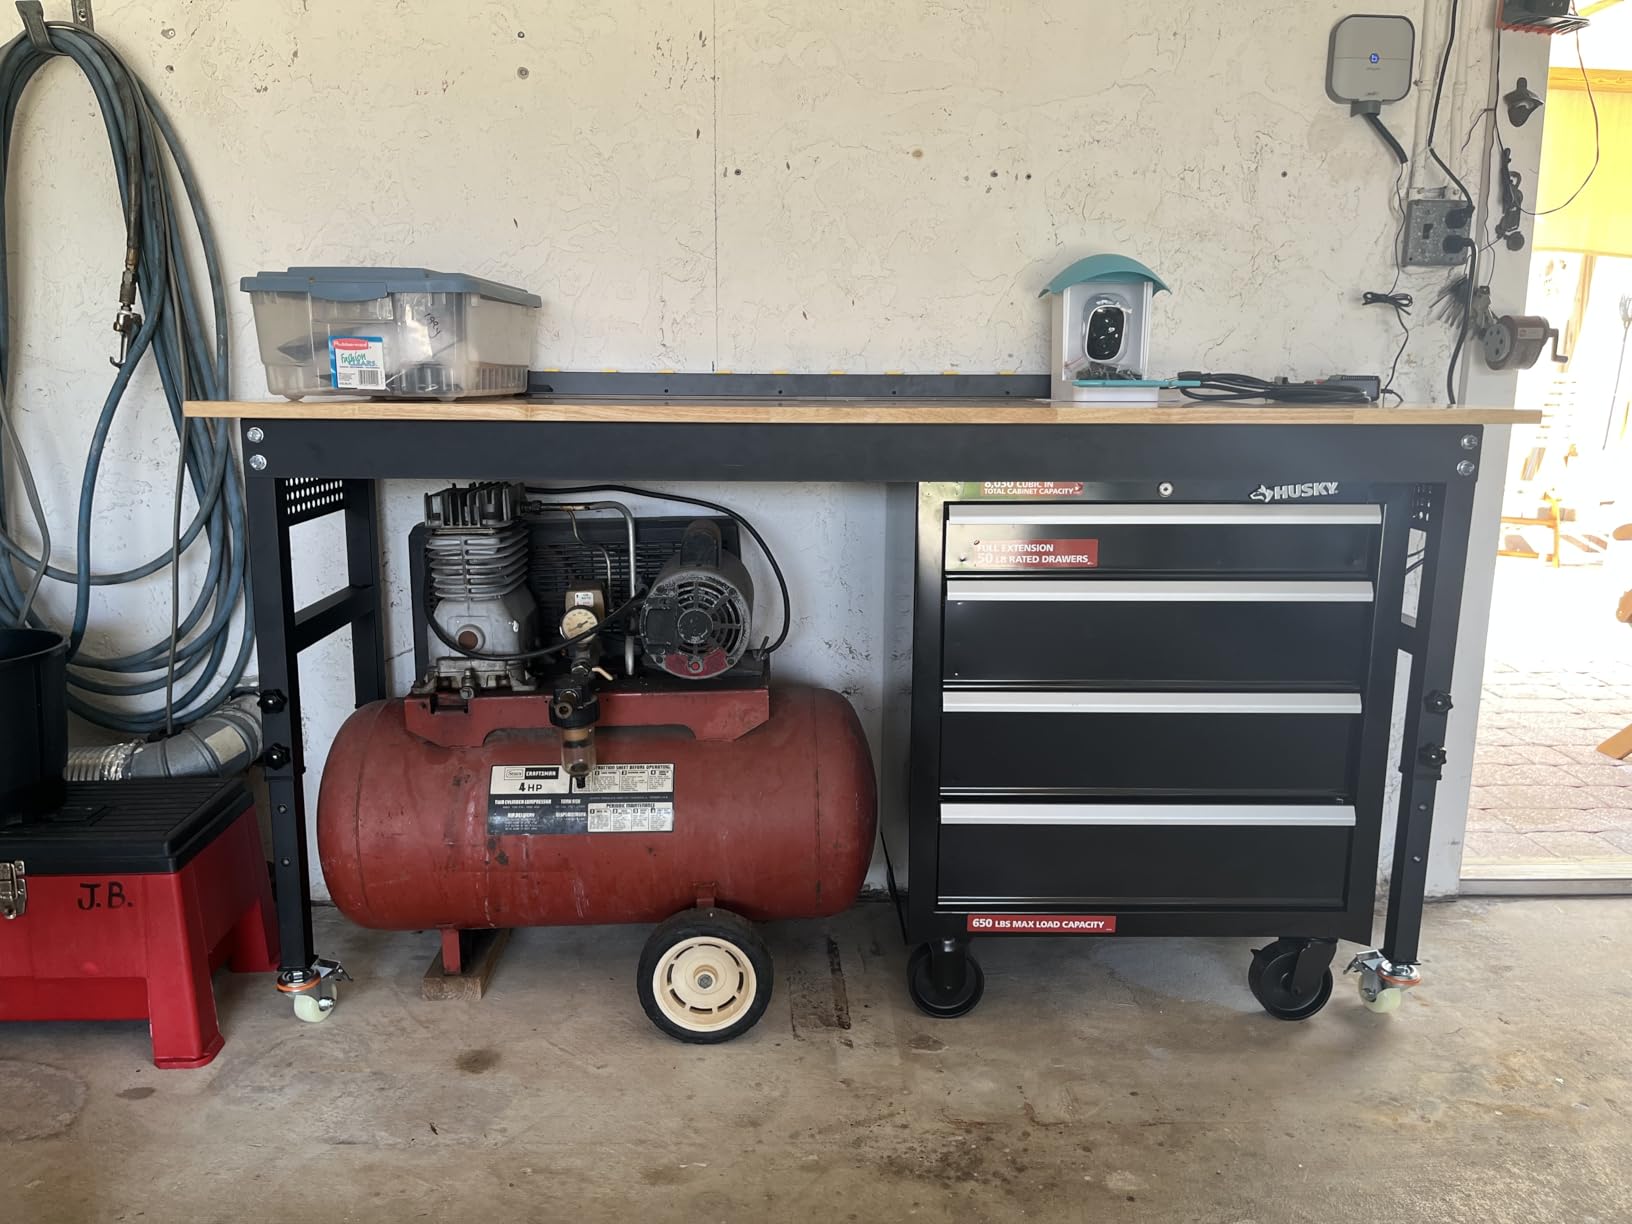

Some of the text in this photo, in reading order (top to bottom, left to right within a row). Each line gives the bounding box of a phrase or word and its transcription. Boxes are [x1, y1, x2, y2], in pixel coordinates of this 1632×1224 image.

[1274, 482, 1338, 500] HUSKY
[1001, 544, 1054, 552] EXTENSION
[1008, 555, 1040, 563] RATED
[1041, 555, 1089, 563] DRAWERS
[519, 782, 542, 792] 4 HP
[78, 881, 133, 910] J.B.
[972, 918, 1104, 929] 650 LBS MAX LOAD CAPACITY
